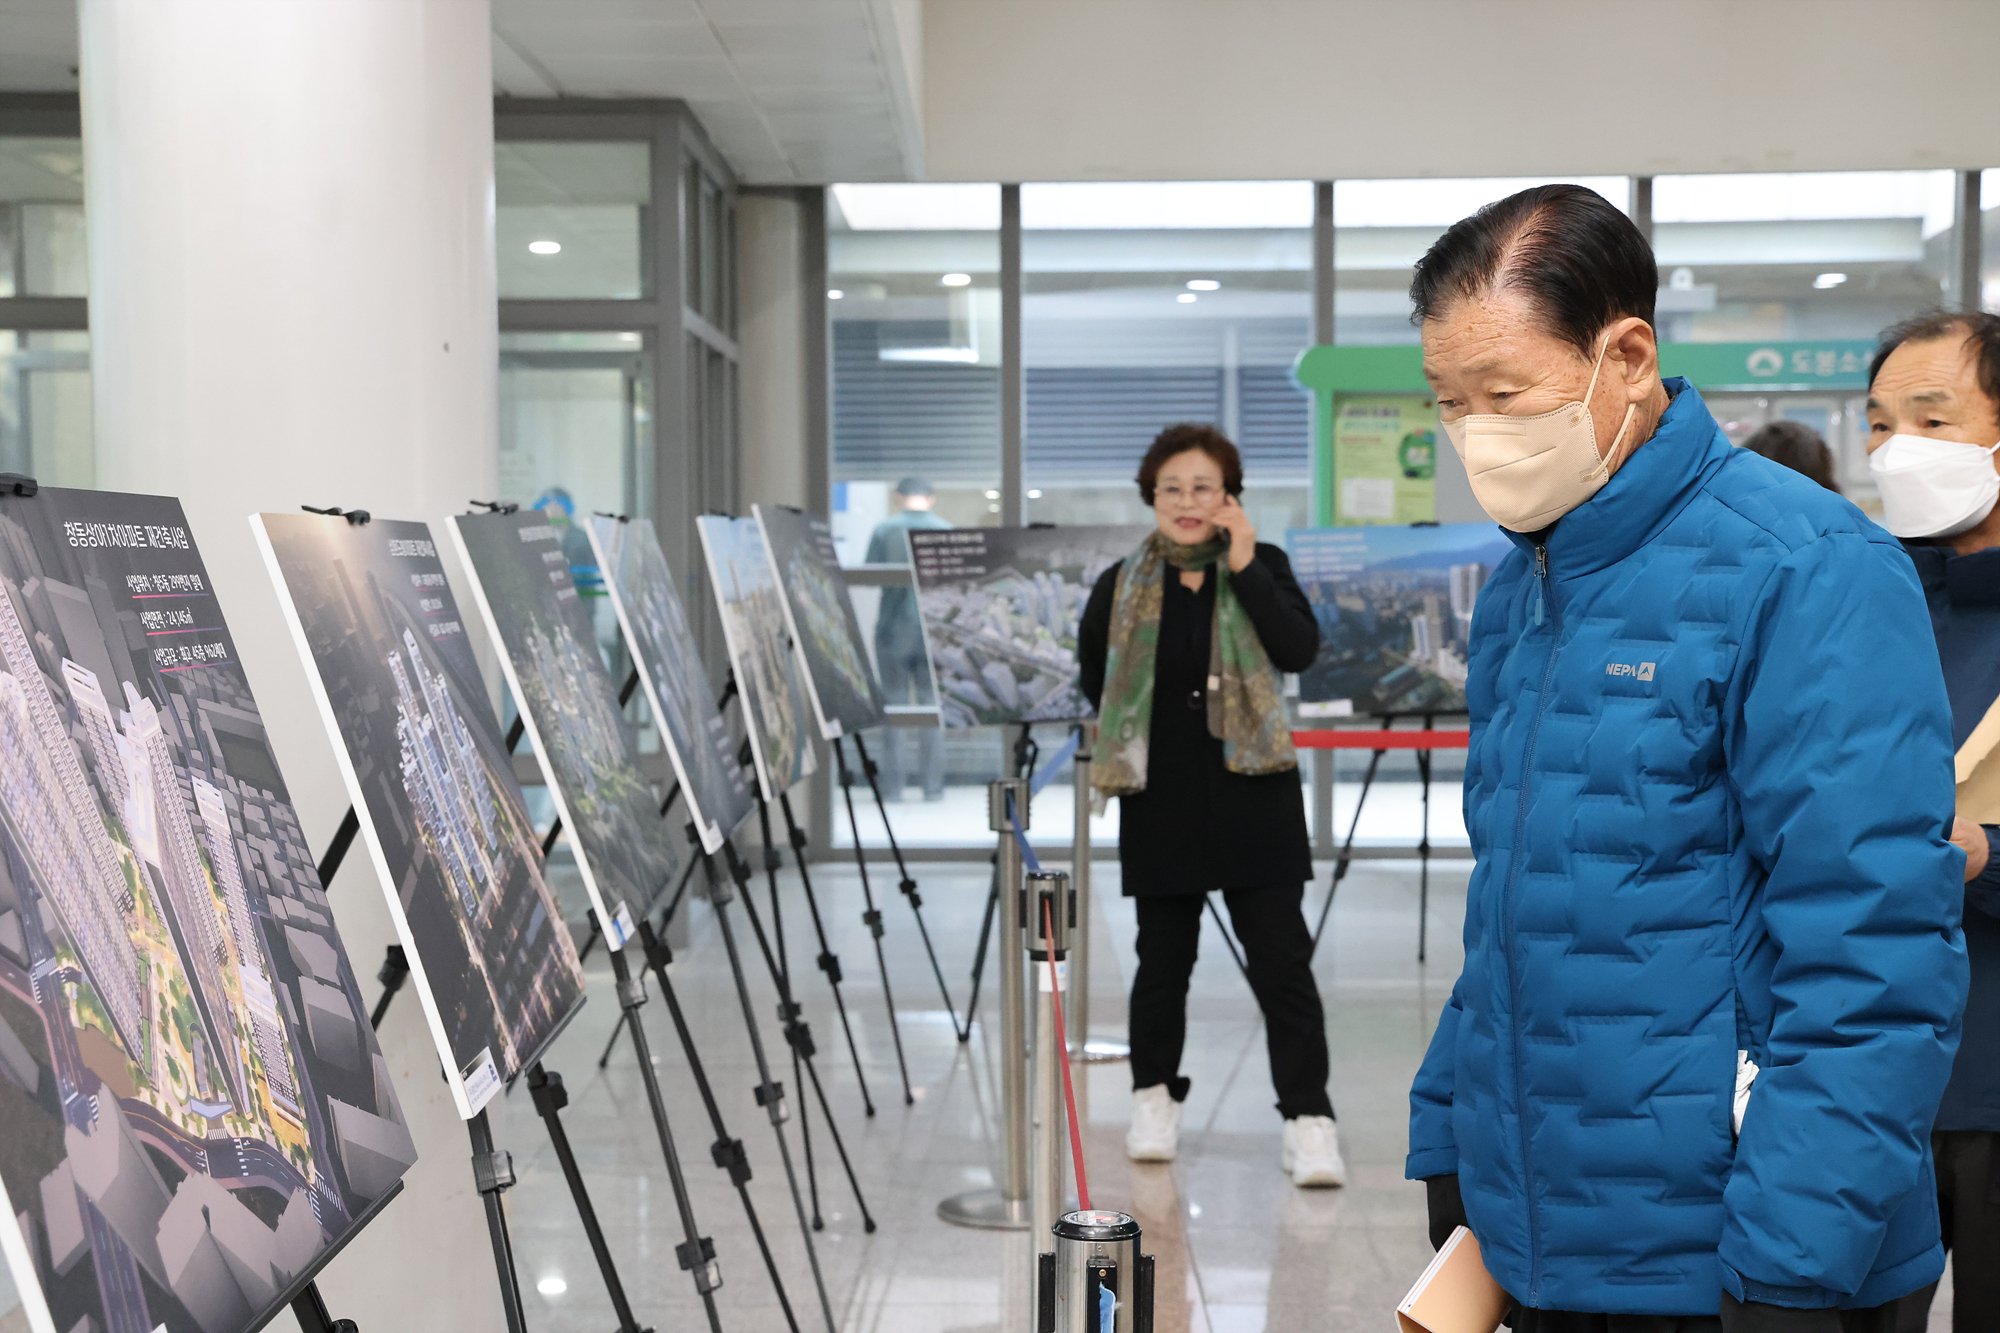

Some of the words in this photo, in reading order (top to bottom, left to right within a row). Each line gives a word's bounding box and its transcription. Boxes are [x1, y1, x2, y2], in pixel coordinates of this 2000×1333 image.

[64, 521, 147, 548] 창동상아1차아파트
[144, 525, 189, 549] 재건축사업
[126, 574, 152, 592] 사업위치
[140, 610, 166, 629] 사업면적
[153, 647, 178, 666] 사업규모
[191, 643, 206, 661] 45층
[1605, 663, 1636, 677] NEPA
